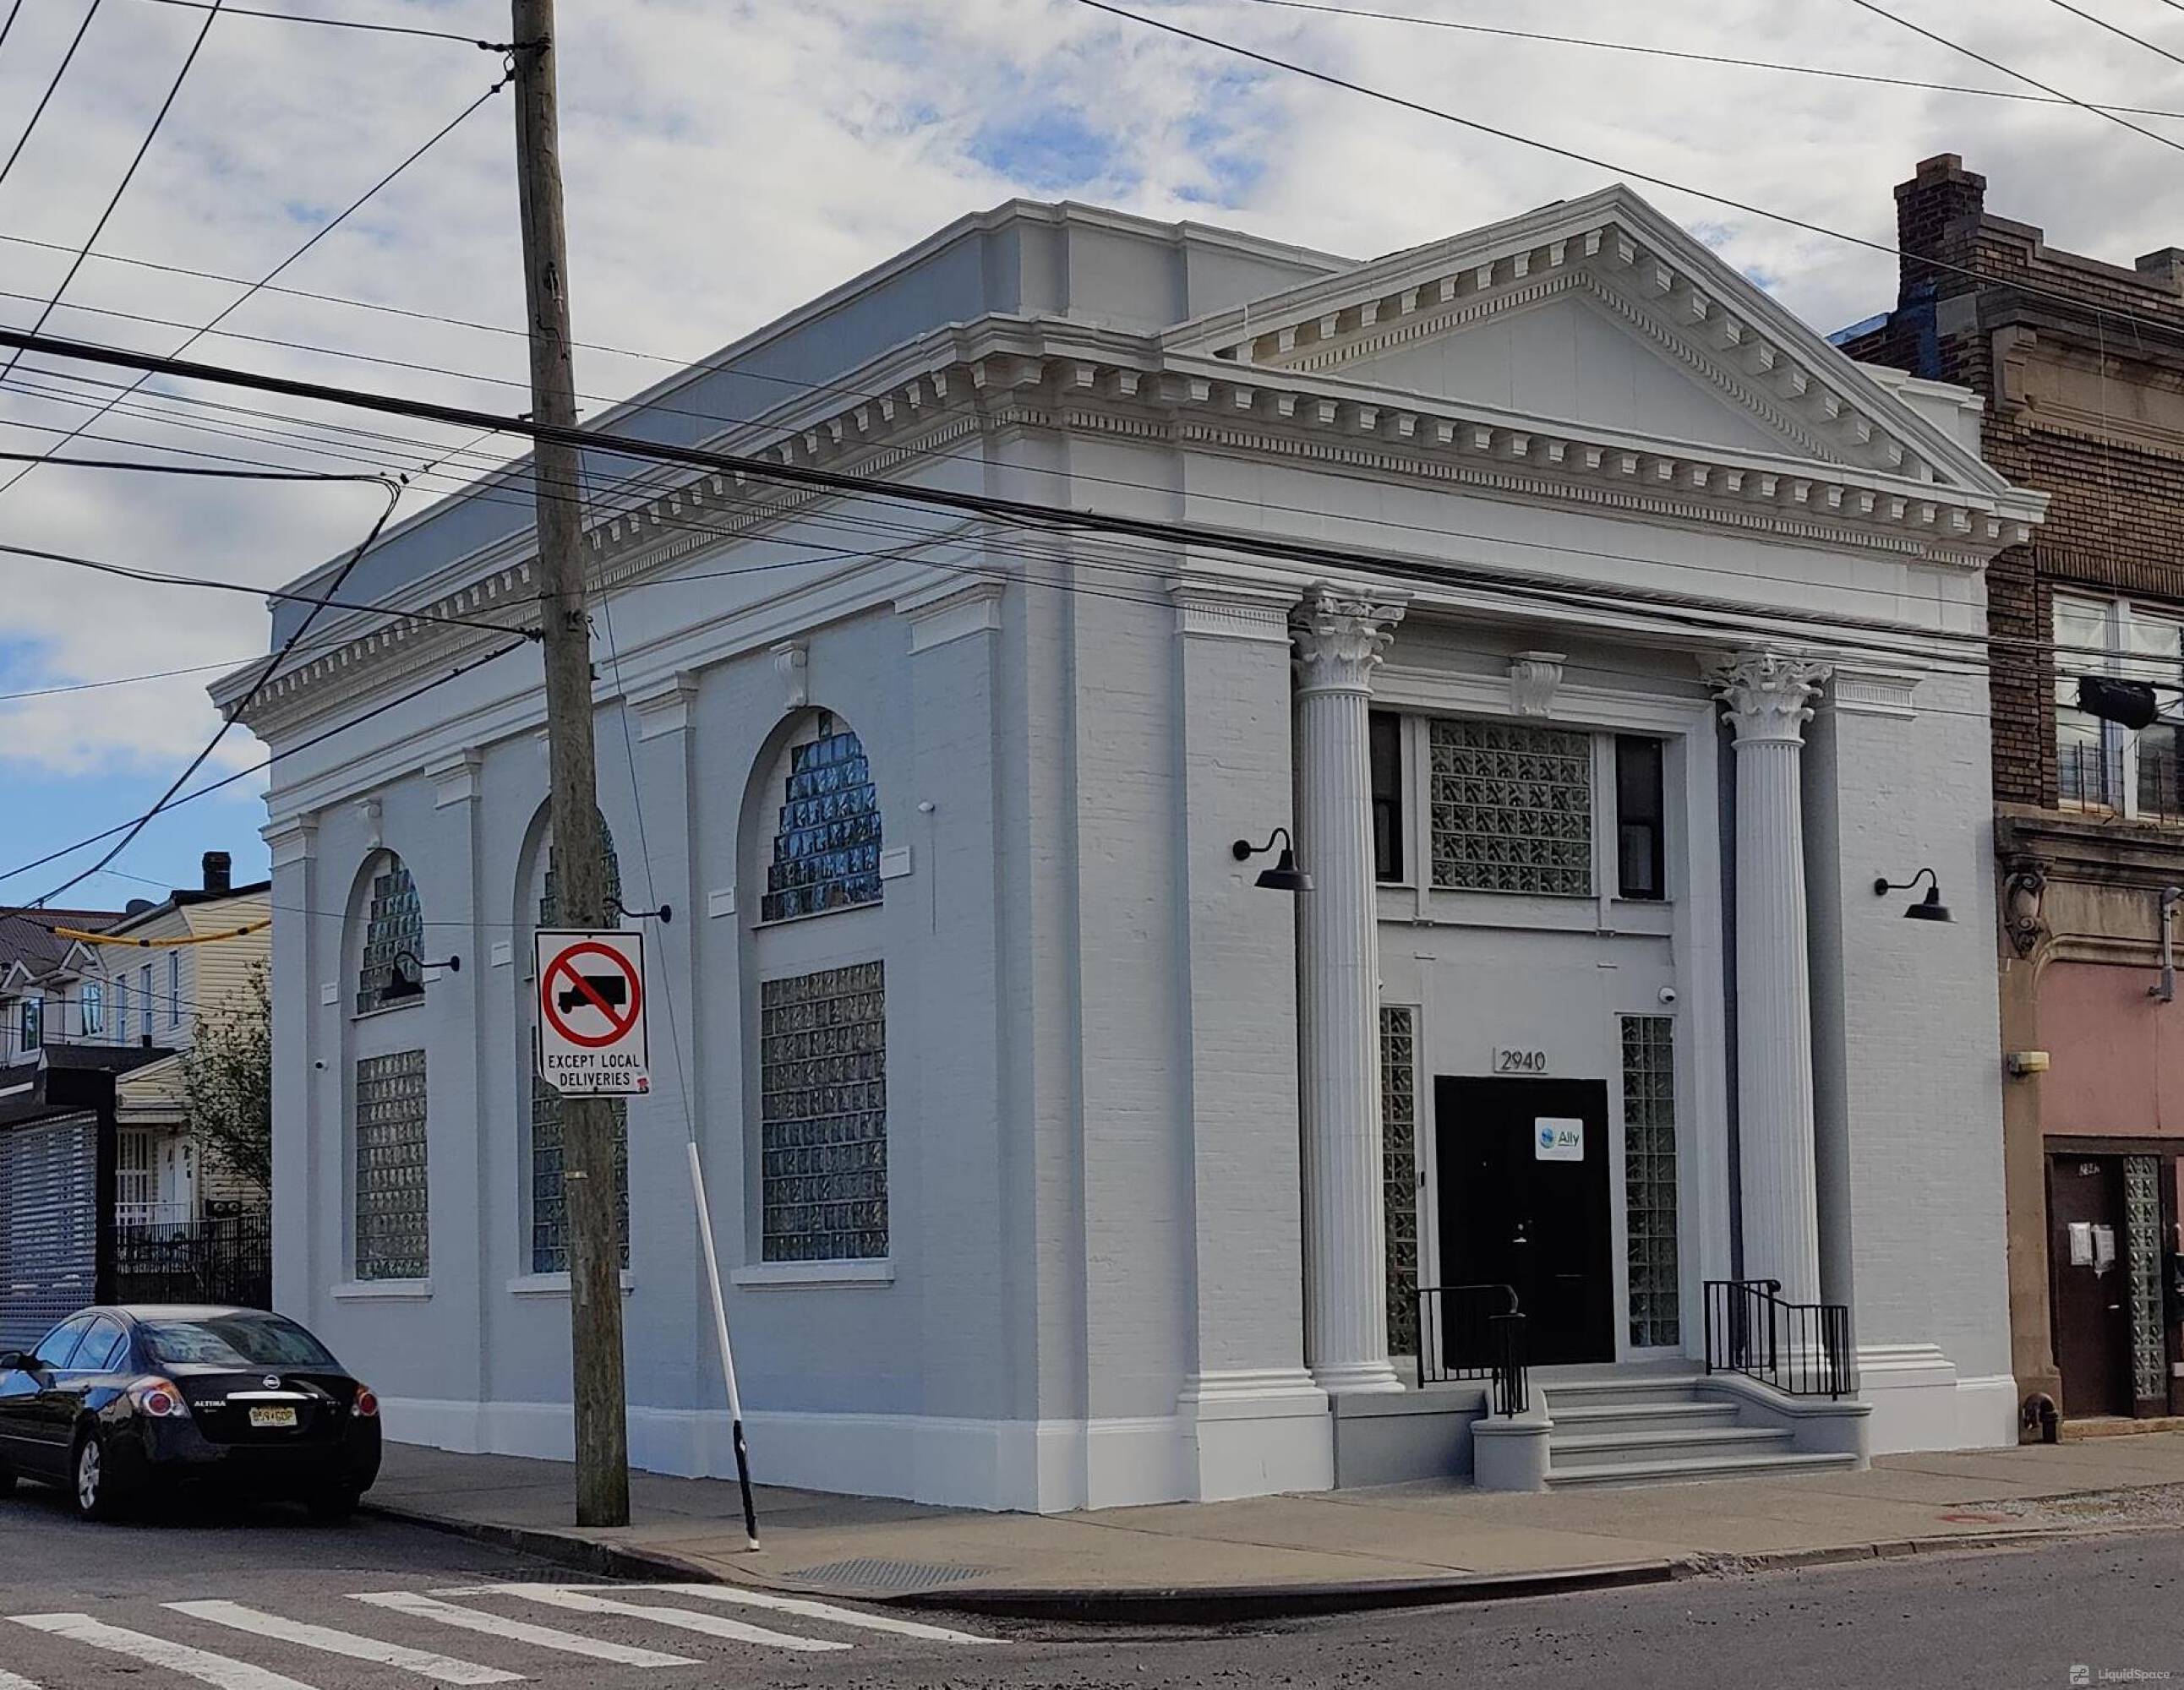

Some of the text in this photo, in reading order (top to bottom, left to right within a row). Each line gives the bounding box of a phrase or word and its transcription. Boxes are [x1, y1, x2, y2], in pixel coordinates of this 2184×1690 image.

[548, 1055, 640, 1068] EXCEPT LOCAL
[1500, 1050, 1545, 1070] 2940
[560, 1072, 630, 1086] DELIVERIES
[1558, 1131, 1580, 1147] Ally
